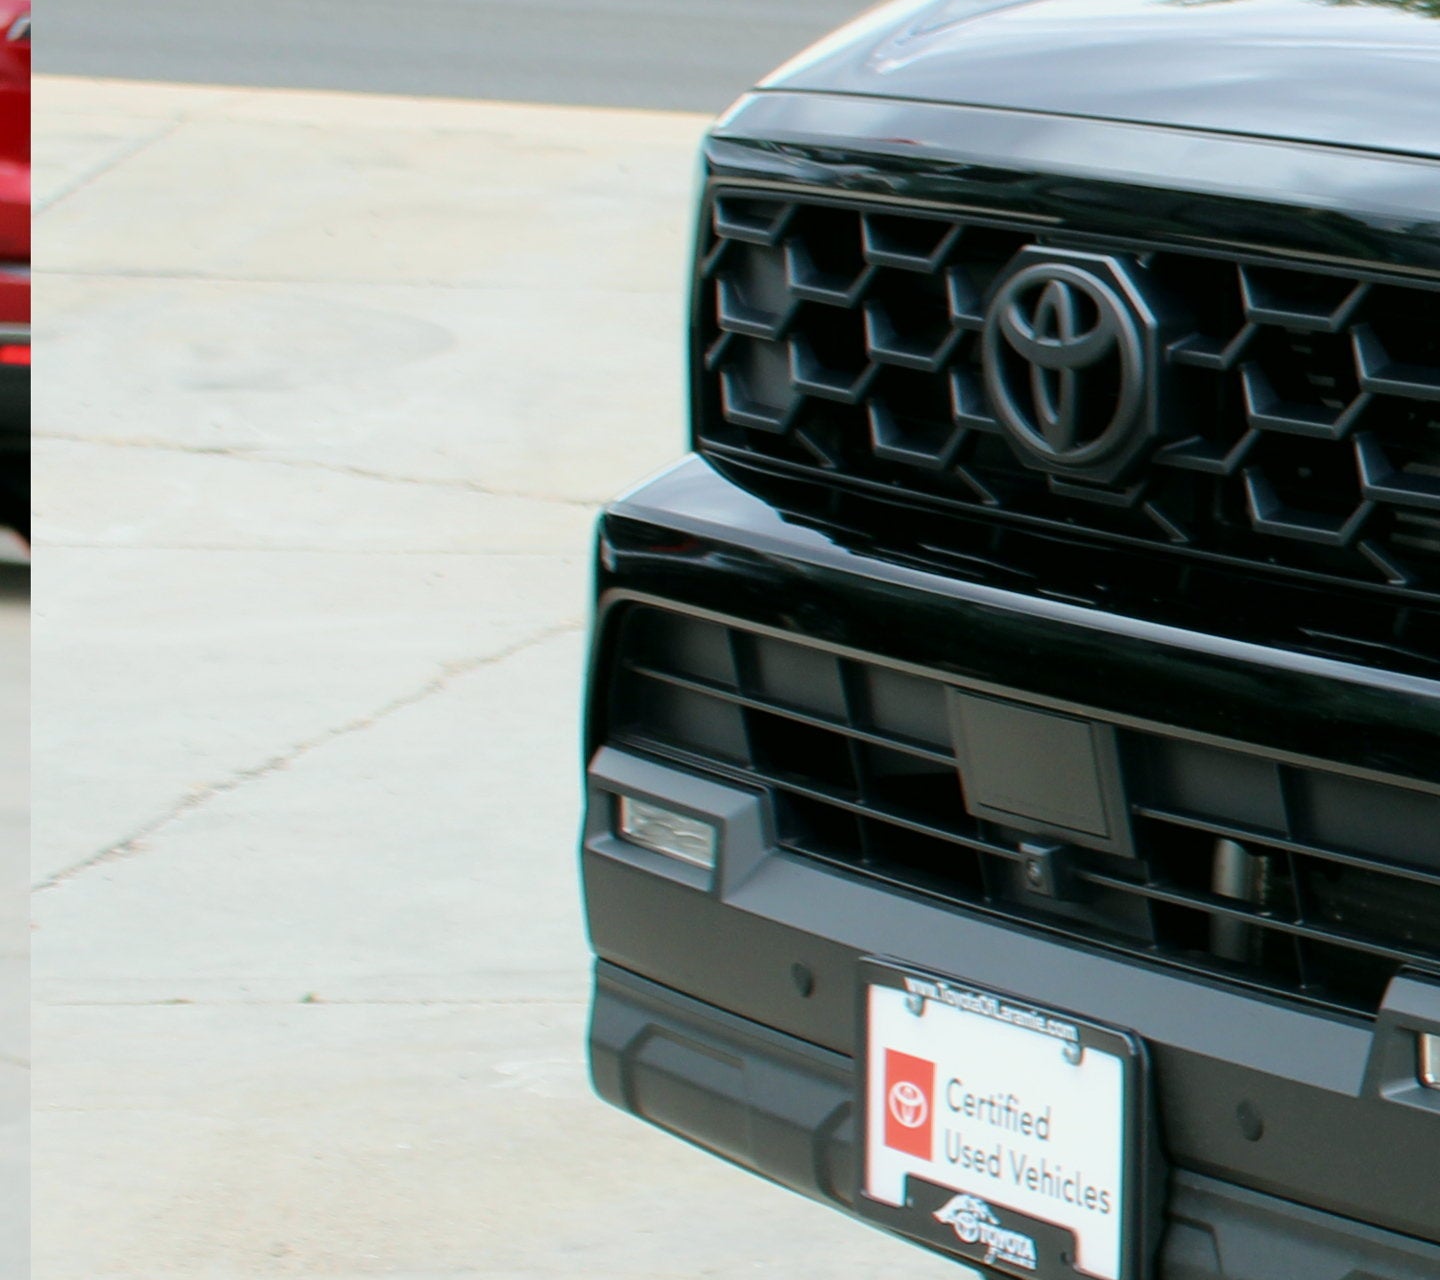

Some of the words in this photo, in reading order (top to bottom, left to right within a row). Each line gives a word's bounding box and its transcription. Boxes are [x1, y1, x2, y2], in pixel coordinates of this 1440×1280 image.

[945, 1077, 1052, 1142] Certified
[944, 1128, 1002, 1179] Used
[1009, 1148, 1111, 1215] Vehicles
